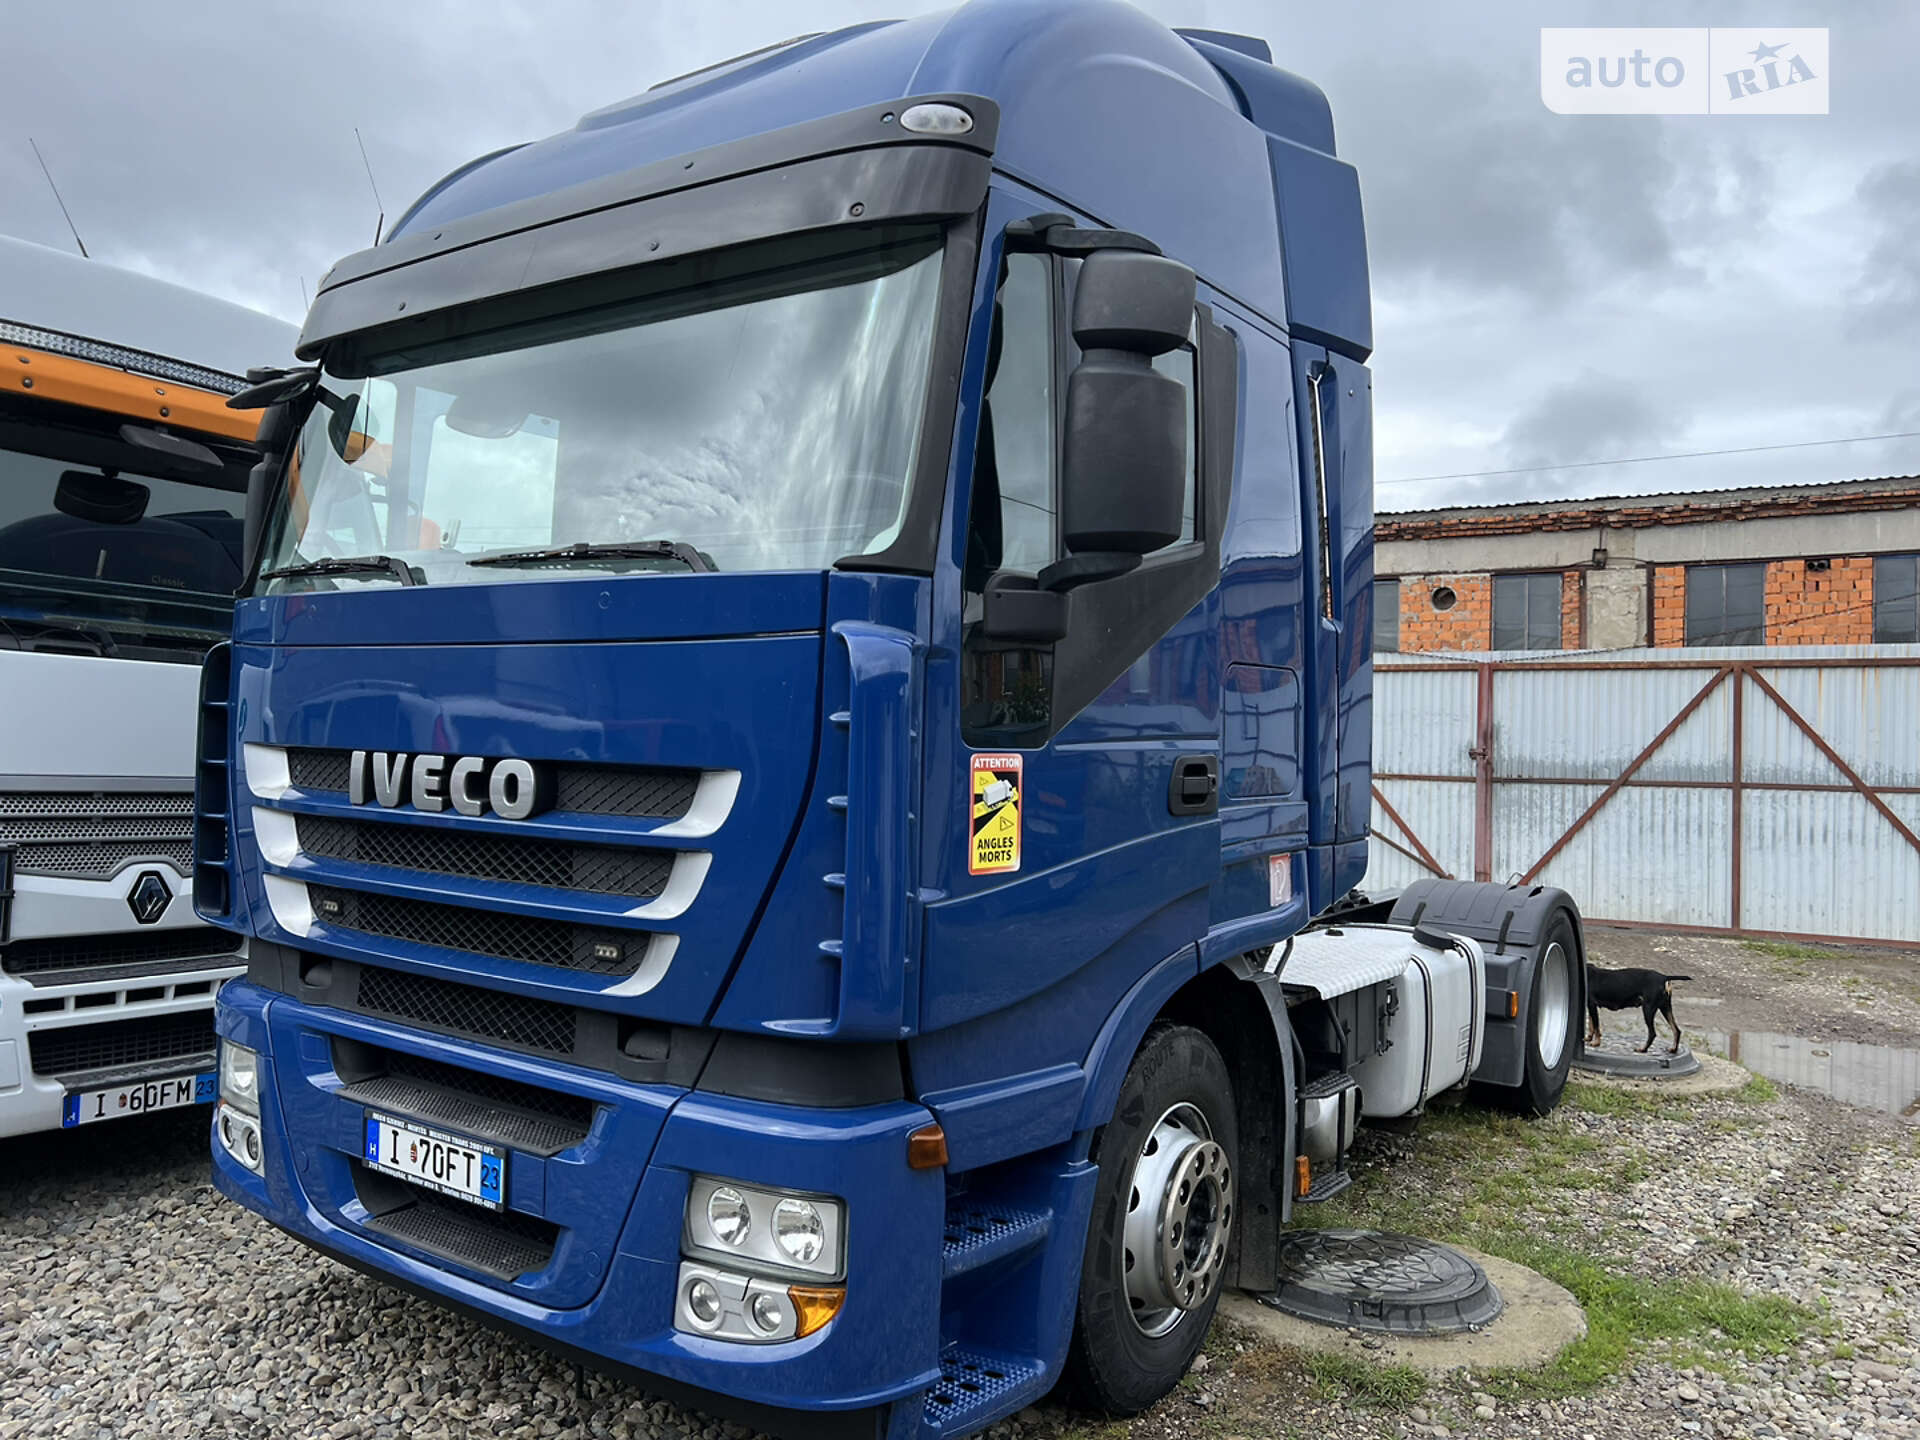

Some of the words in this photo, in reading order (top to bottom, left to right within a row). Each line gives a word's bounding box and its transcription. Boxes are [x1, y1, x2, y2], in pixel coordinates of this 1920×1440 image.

[974, 757, 1020, 769] ATTENTION
[350, 751, 536, 820] IVECO
[977, 836, 1014, 850] ANGLES
[979, 850, 1012, 863] MORTS
[196, 1080, 215, 1095] 23
[390, 1130, 399, 1165] I
[481, 1164, 499, 1191] 23
